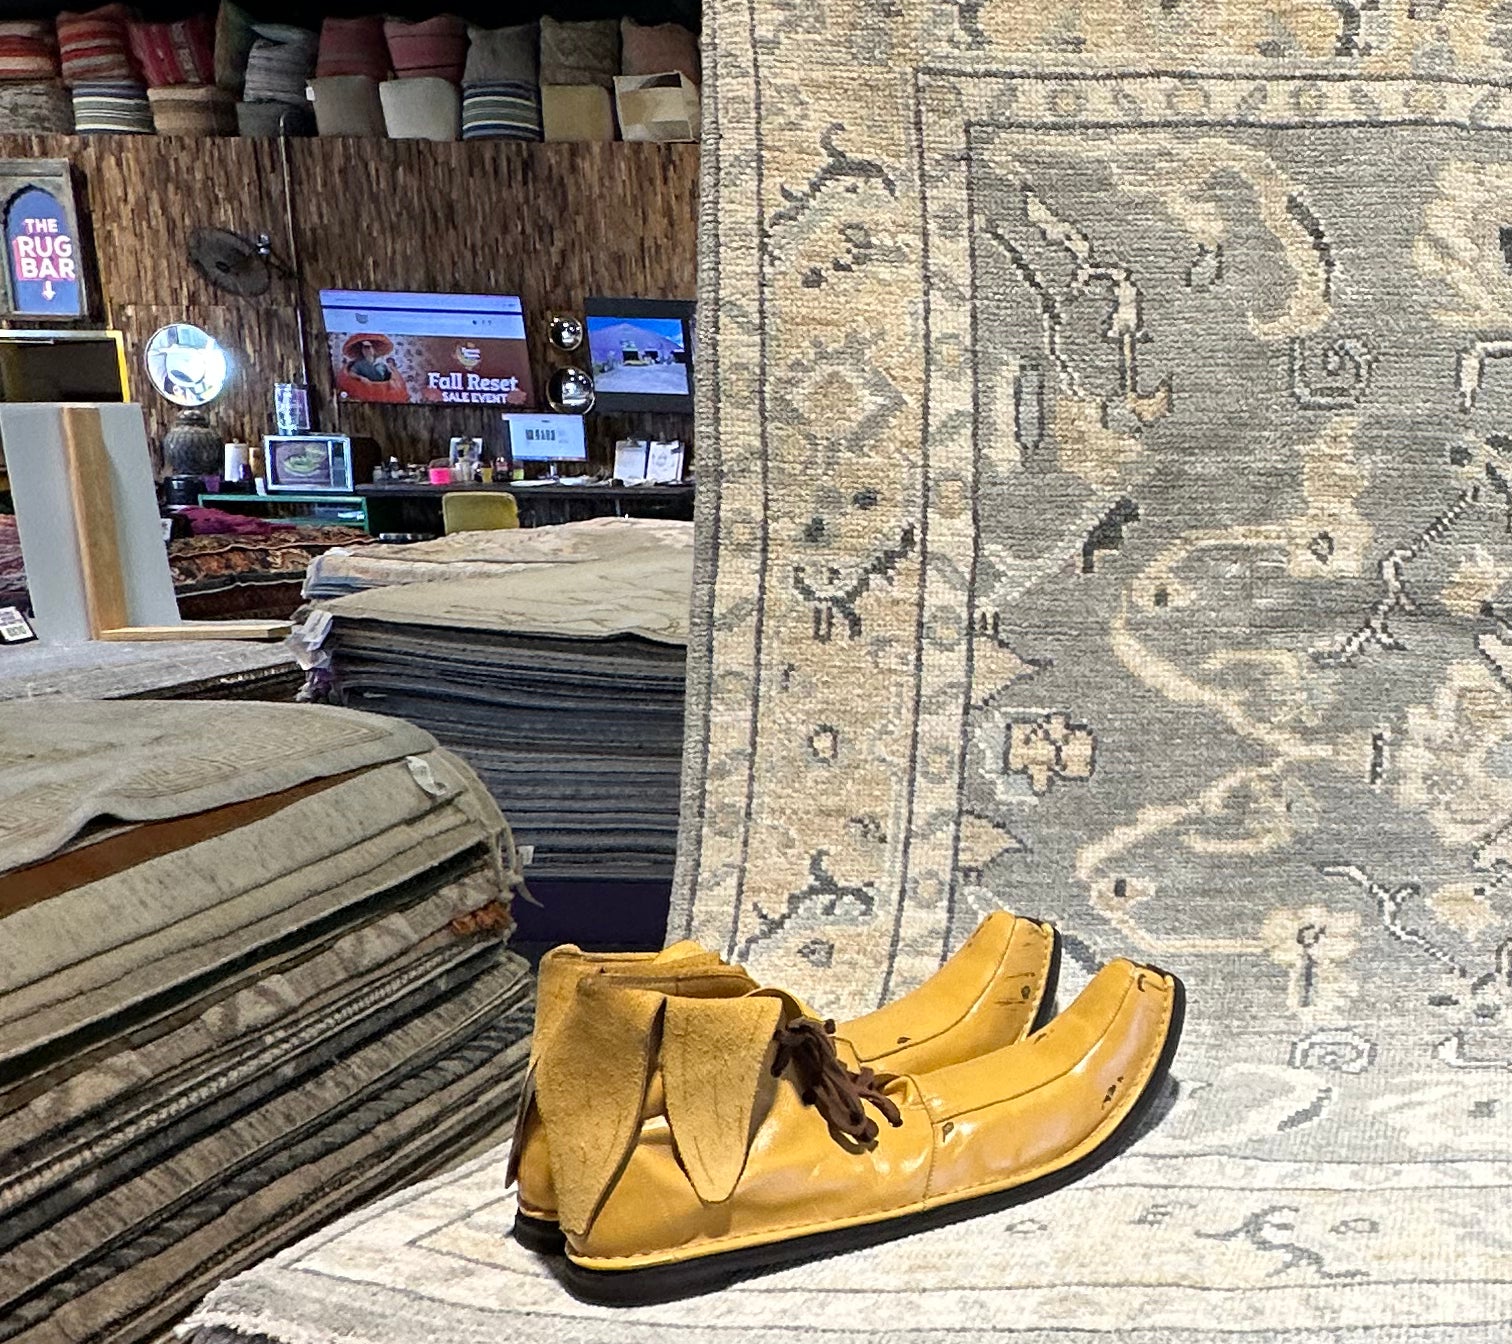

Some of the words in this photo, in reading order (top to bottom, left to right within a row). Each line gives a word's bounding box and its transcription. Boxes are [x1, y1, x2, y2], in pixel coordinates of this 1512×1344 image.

[24, 218, 58, 234] THE
[15, 235, 72, 257] RUG
[19, 257, 75, 279] BAR
[427, 372, 462, 391] Fall
[467, 372, 519, 392] Reset
[441, 391, 470, 403] SALE
[471, 392, 507, 404] EVENT
